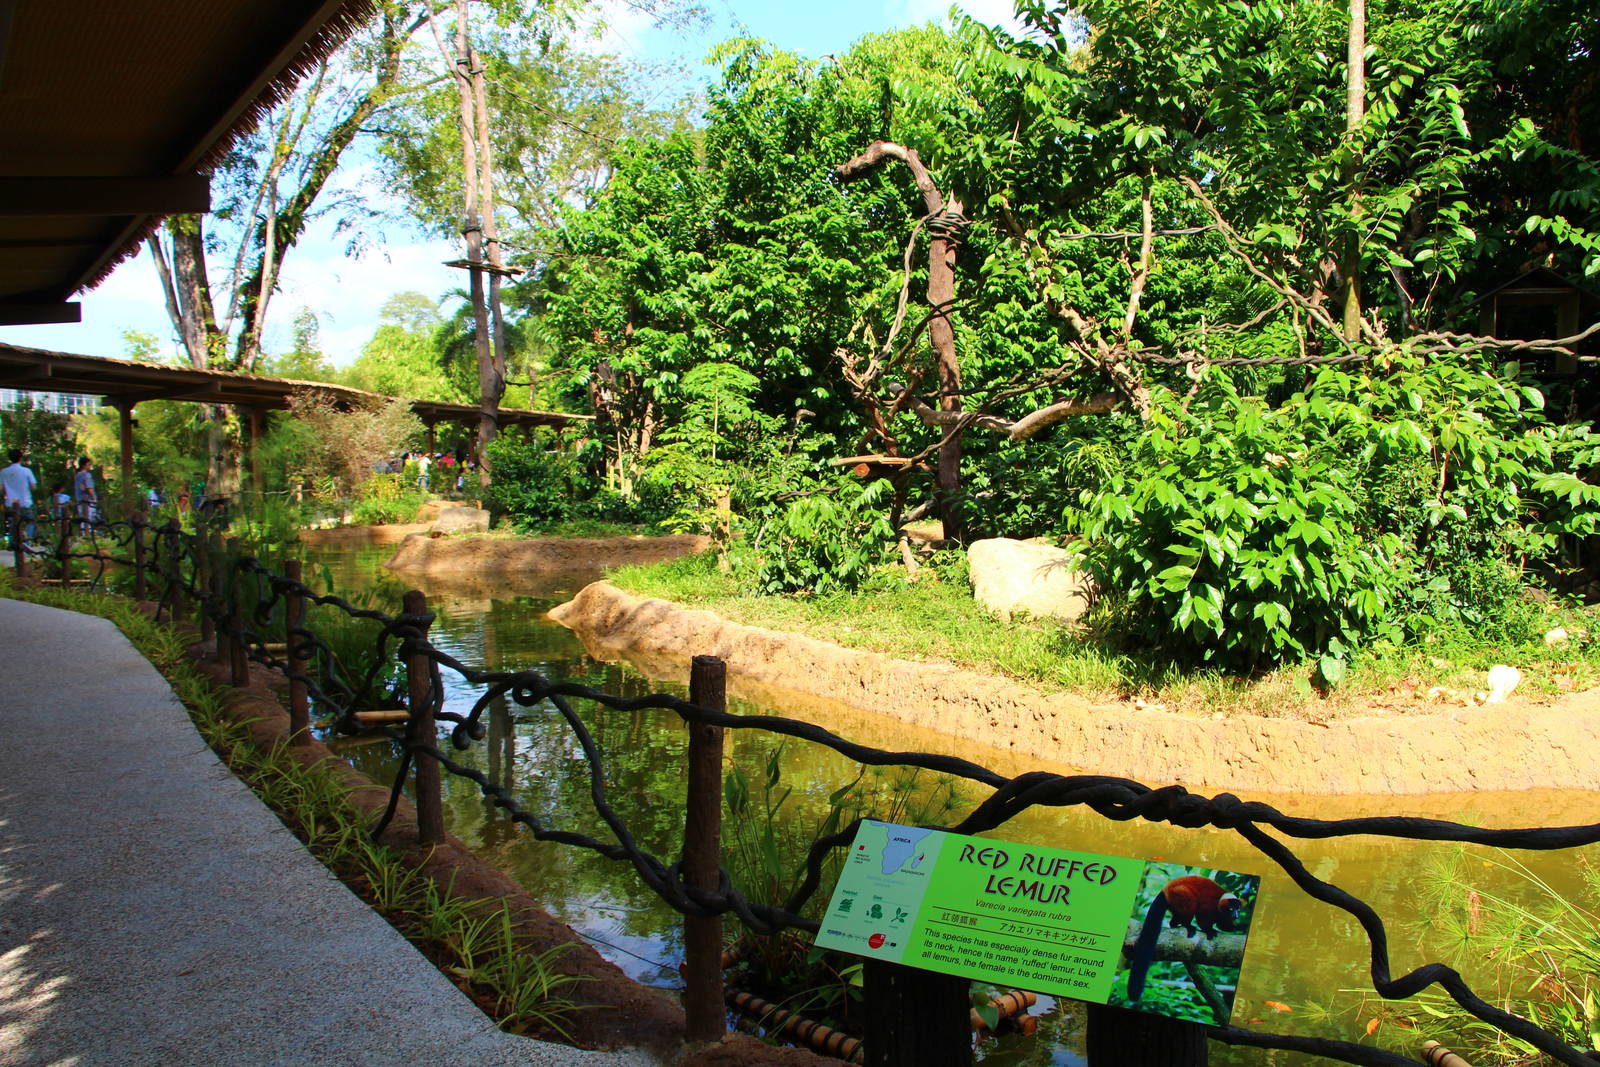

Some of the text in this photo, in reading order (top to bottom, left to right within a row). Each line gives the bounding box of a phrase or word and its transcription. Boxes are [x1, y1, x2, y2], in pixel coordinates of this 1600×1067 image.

[959, 844, 1117, 886] RED RUFFED
[984, 874, 1070, 905] LEMUR
[975, 899, 1072, 922] Varecia variegata rubra
[924, 927, 1105, 967] This species has especially dense fur around
[999, 922, 1097, 946] アカエリマキキツネザル
[921, 950, 932, 959] all
[963, 959, 977, 967] the
[978, 961, 1006, 973] female
[1007, 965, 1015, 975] is
[1016, 969, 1031, 978] the
[1032, 971, 1072, 985] dominant
[1073, 980, 1090, 989] sex.
[923, 939, 933, 948] its
[934, 942, 955, 953] neck,
[957, 946, 983, 957] hence
[983, 951, 994, 959] its
[995, 954, 1019, 964] name
[1050, 962, 1075, 975] lemur.
[1078, 967, 1097, 978] Like
